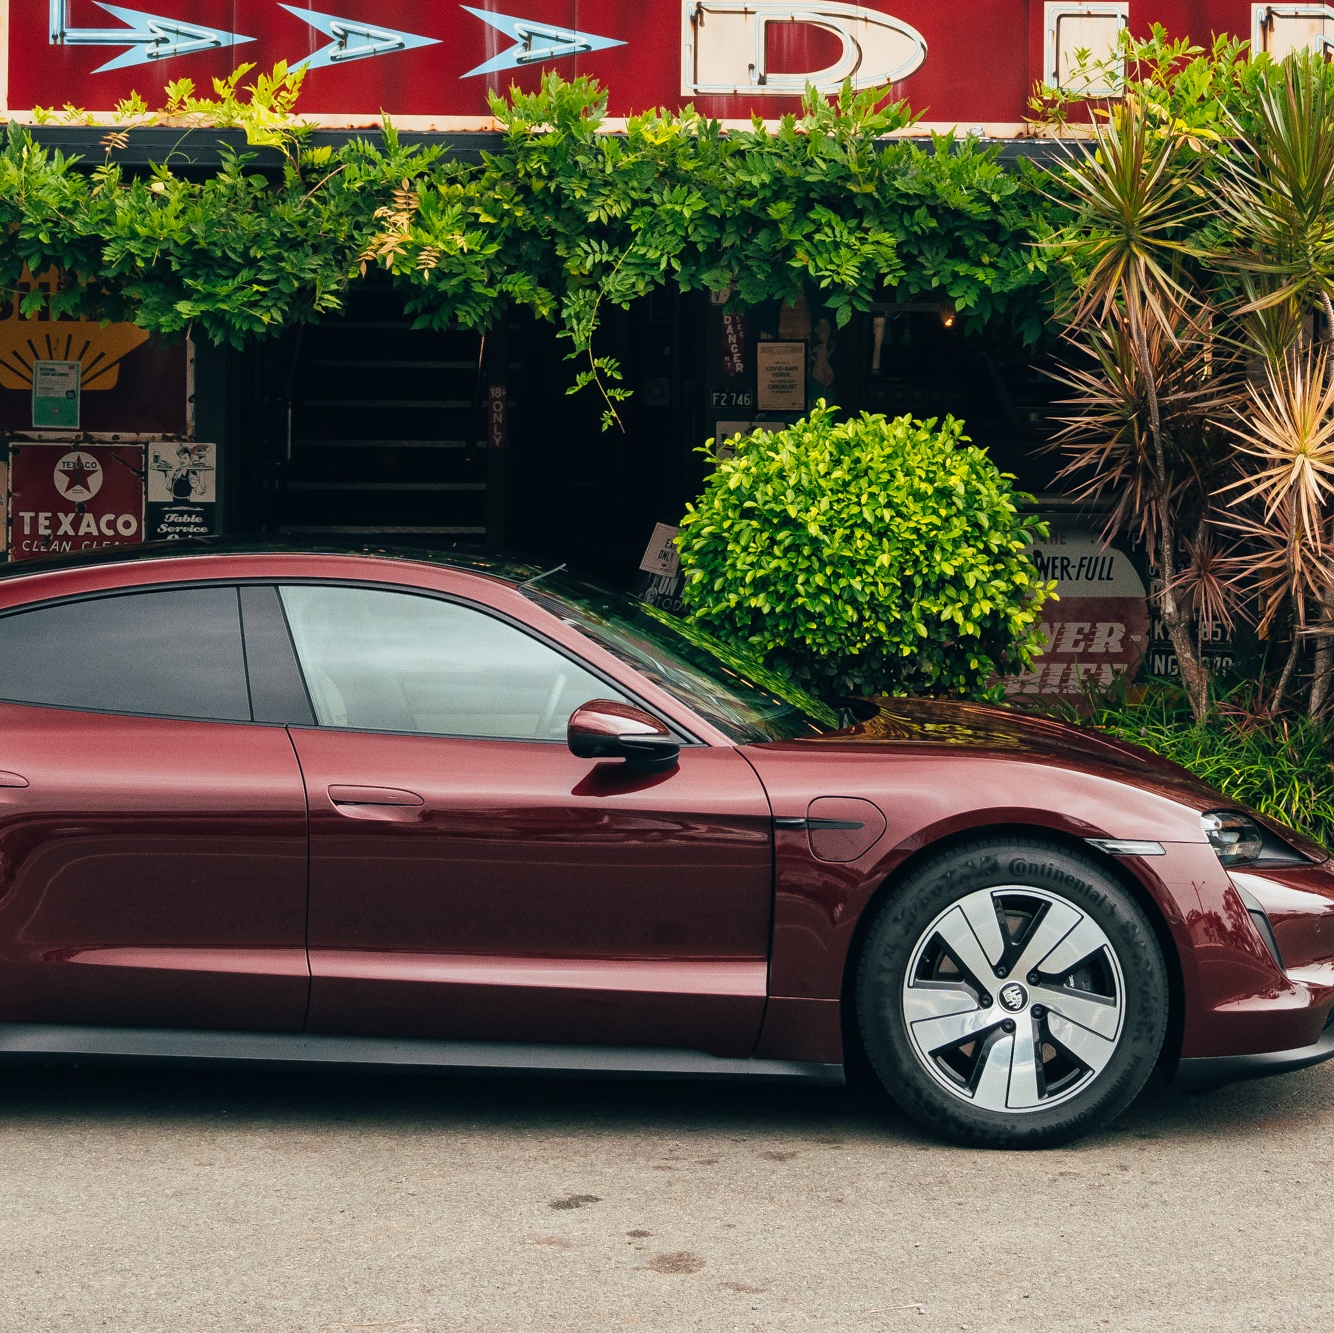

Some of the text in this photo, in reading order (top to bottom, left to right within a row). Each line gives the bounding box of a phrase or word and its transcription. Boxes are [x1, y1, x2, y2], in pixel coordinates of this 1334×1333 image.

[724, 316, 744, 372] DANGER
[490, 387, 506, 398] 18+
[493, 401, 503, 446] ONLY
[62, 461, 97, 469] TEXACO
[19, 512, 137, 536] TEXACO
[164, 513, 203, 524] Table
[156, 524, 208, 534] Service
[22, 540, 71, 553] CLEAN
[1034, 556, 1114, 582] WER-FULL
[1008, 857, 1109, 907] Continental
